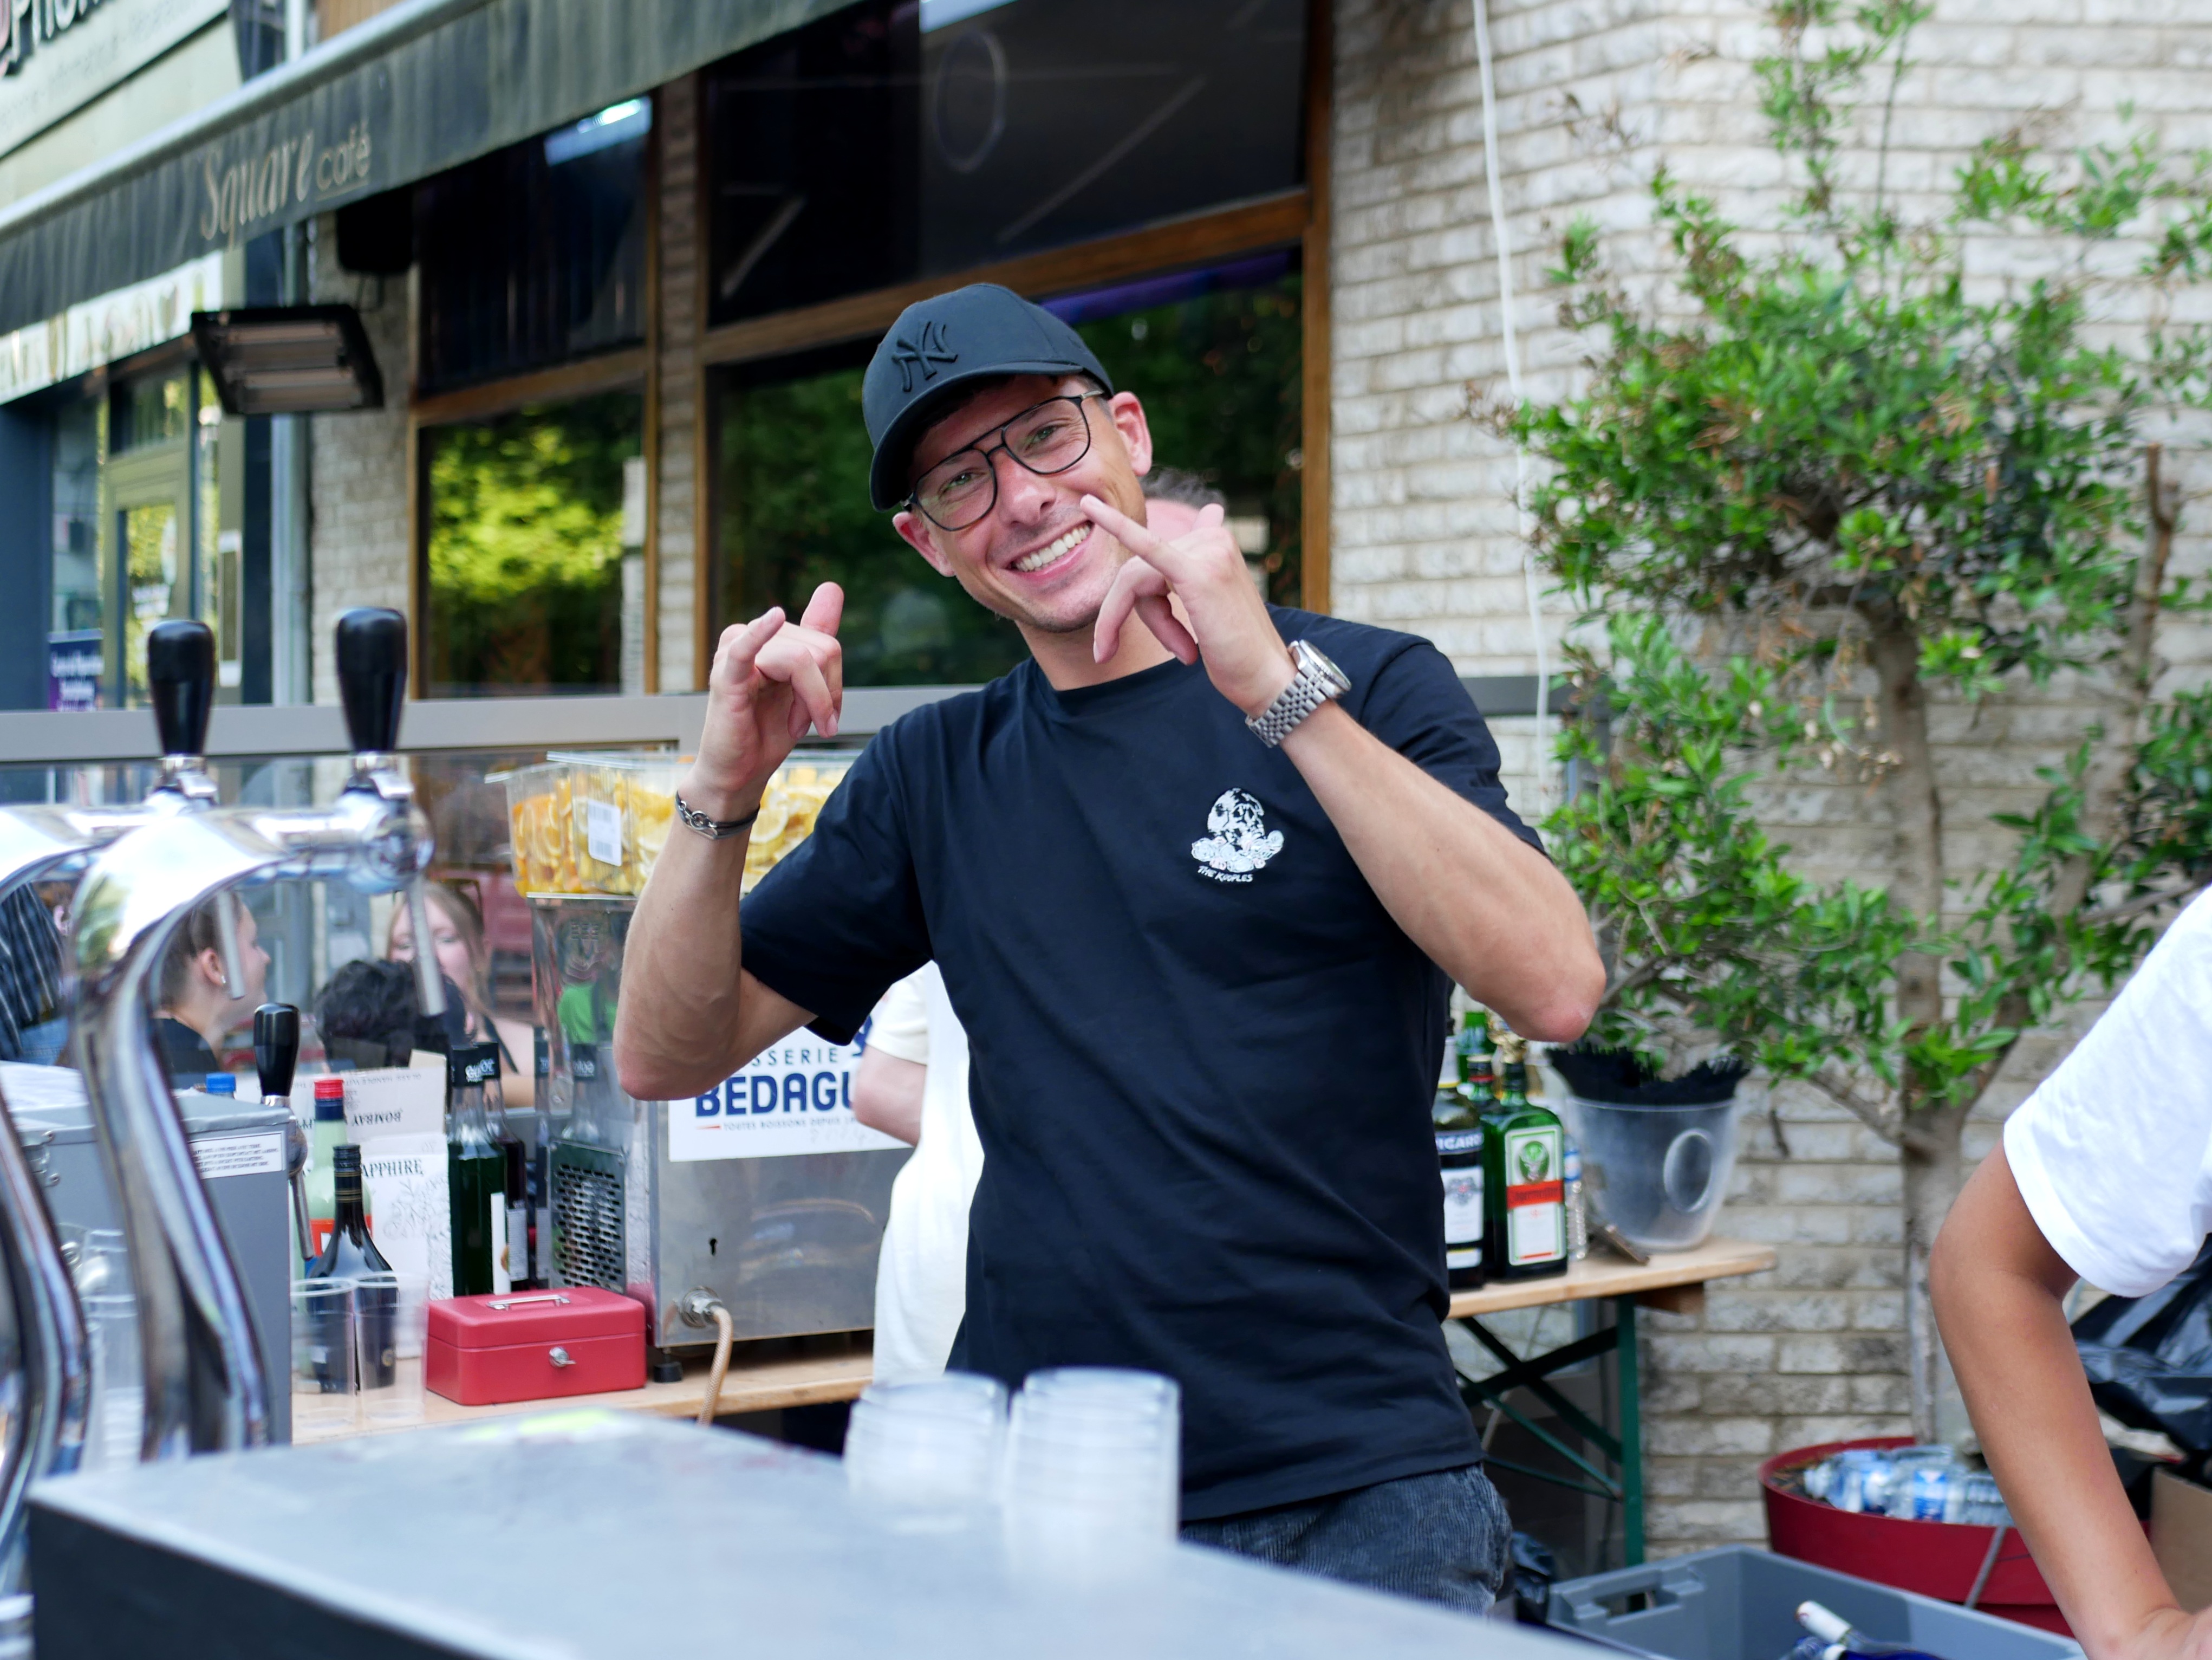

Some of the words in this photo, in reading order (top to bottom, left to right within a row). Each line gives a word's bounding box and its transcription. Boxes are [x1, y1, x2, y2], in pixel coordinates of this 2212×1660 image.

[201, 130, 314, 249] Square
[892, 321, 958, 392] NY
[1198, 865, 1217, 878] THE
[751, 1048, 838, 1067] SSERIE
[352, 1111, 402, 1127] BOMBAY
[761, 1119, 806, 1130] BOISSONS
[1435, 1133, 1482, 1150] ICARD
[361, 1159, 424, 1178] APPHIRE
